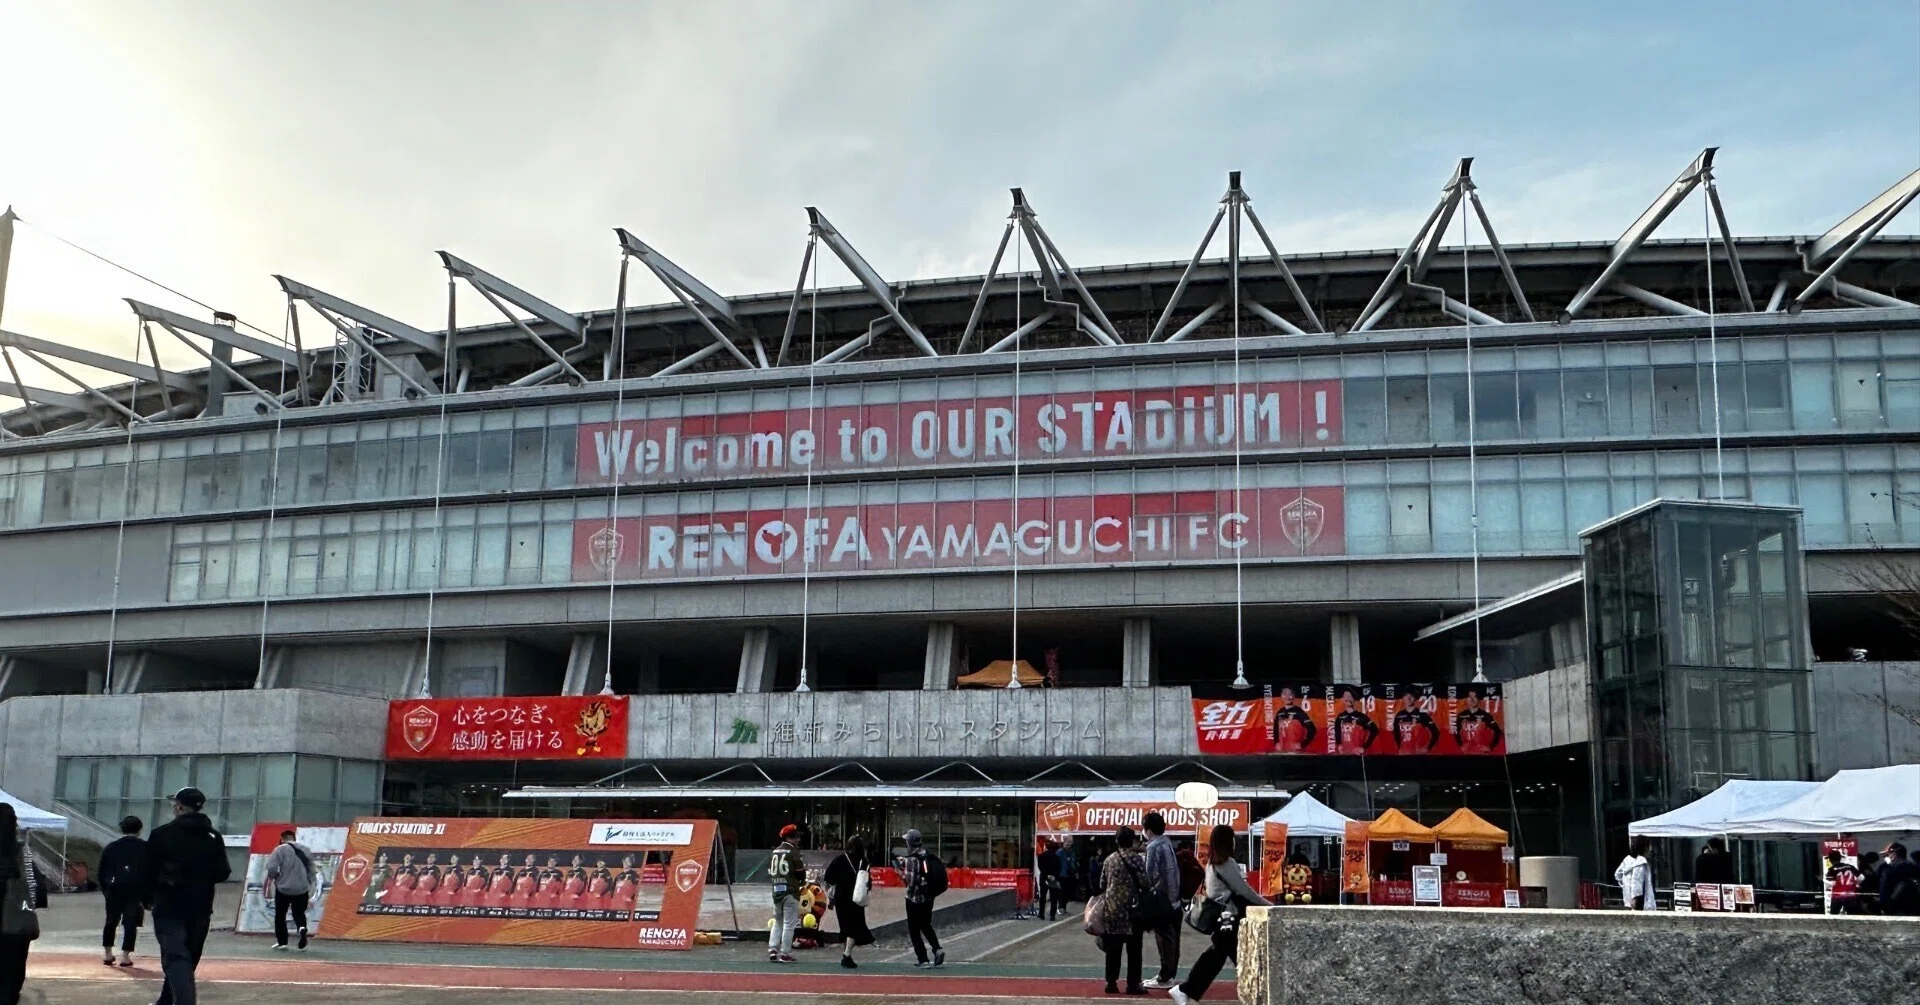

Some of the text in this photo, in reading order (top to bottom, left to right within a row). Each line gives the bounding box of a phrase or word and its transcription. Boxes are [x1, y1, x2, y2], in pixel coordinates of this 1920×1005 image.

[595, 427, 815, 476] Welcome
[839, 419, 887, 463] to
[912, 407, 1014, 459] OUR
[1037, 392, 1281, 453] STADIUM
[648, 513, 1249, 570] RENOFA YAMAGUCHI FC
[1200, 701, 1255, 724] 全力
[1301, 695, 1311, 712] 6
[1418, 694, 1437, 713] 20
[1483, 695, 1500, 713] 17
[453, 704, 556, 726] 心をつなぎ、
[451, 729, 563, 751] 感動を届ける
[772, 719, 1103, 744] 維新みらいふスタジアム
[1085, 807, 1240, 827] OFFICIAL OODS SHOP
[391, 823, 433, 835] STARTING
[1836, 870, 1854, 886] 12
[639, 927, 687, 939] RENOFA
